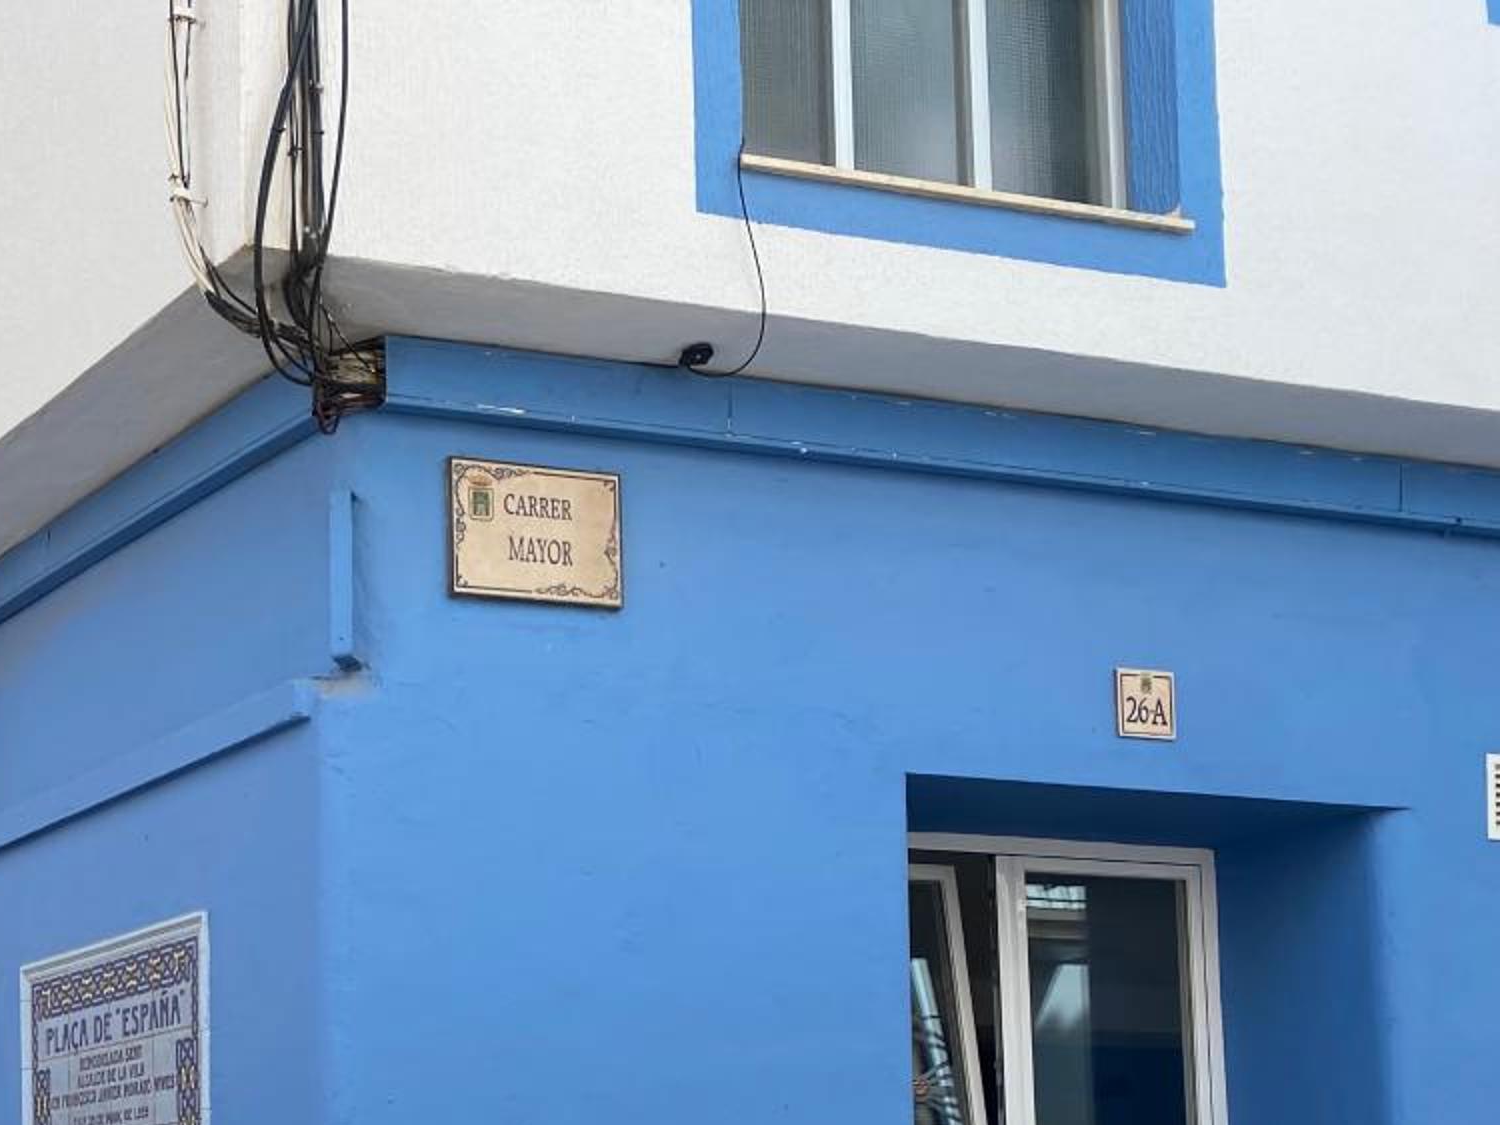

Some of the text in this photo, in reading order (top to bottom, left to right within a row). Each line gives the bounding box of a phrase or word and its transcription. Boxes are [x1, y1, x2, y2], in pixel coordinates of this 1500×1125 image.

[503, 493, 572, 520] CARRER
[508, 535, 573, 566] MAYOR
[46, 1017, 90, 1058] PLAÇA
[93, 1011, 113, 1044] DE
